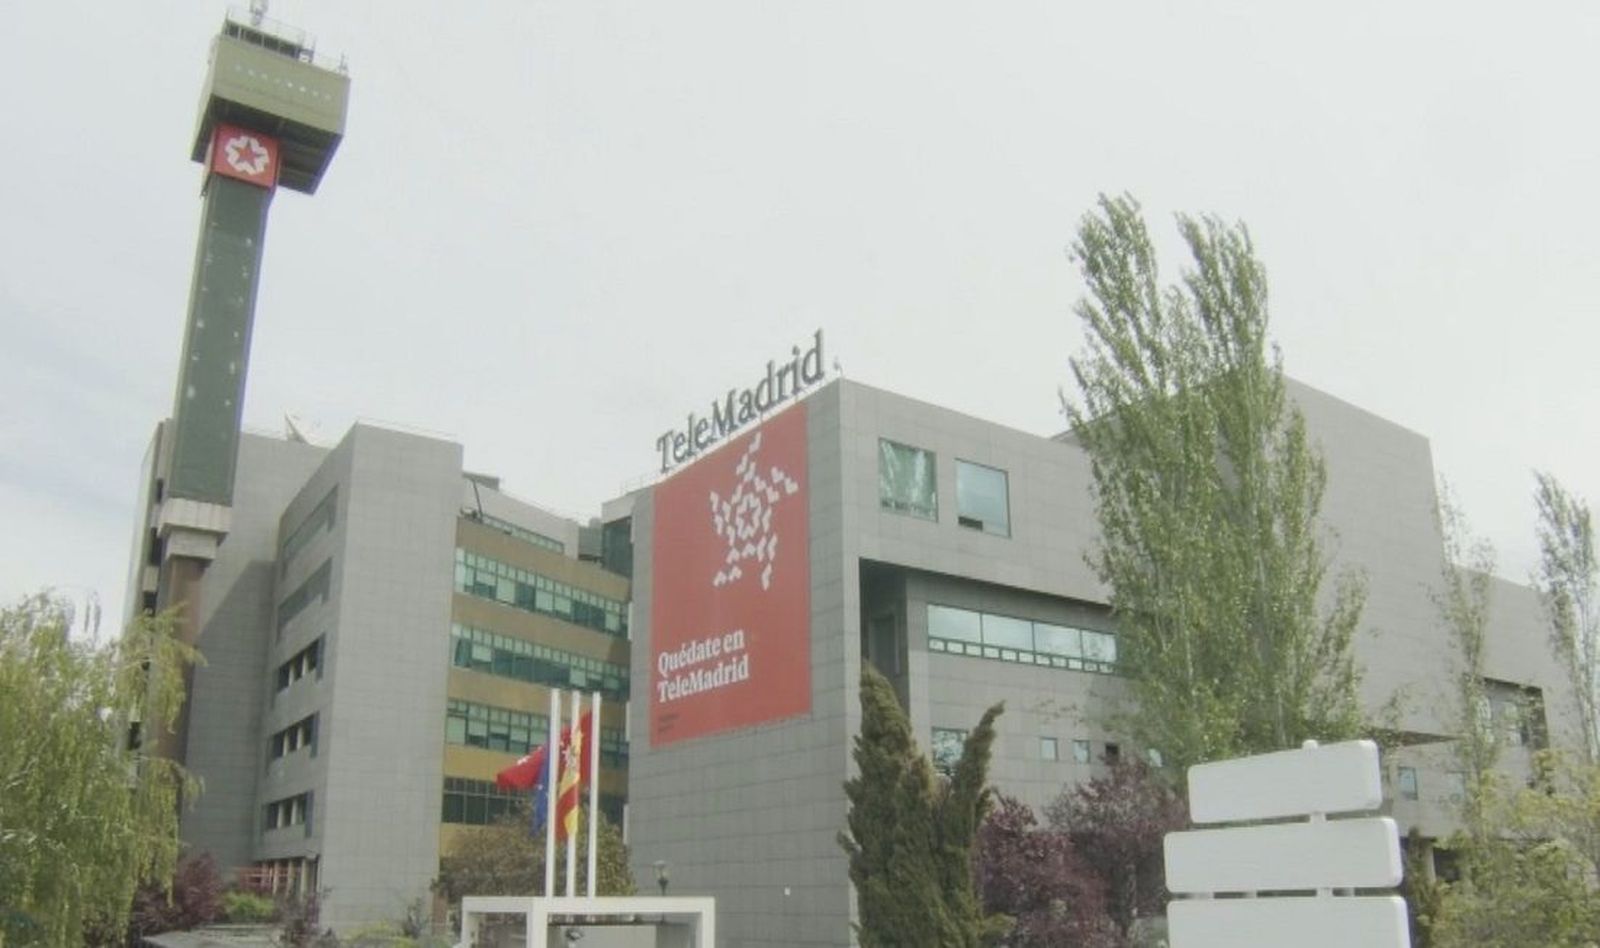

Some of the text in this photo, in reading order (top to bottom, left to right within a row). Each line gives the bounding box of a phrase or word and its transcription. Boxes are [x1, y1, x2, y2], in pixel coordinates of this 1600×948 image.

[656, 328, 825, 473] TeleMadrid
[658, 629, 745, 677] Quédate en
[657, 654, 750, 703] TeleMadrid
